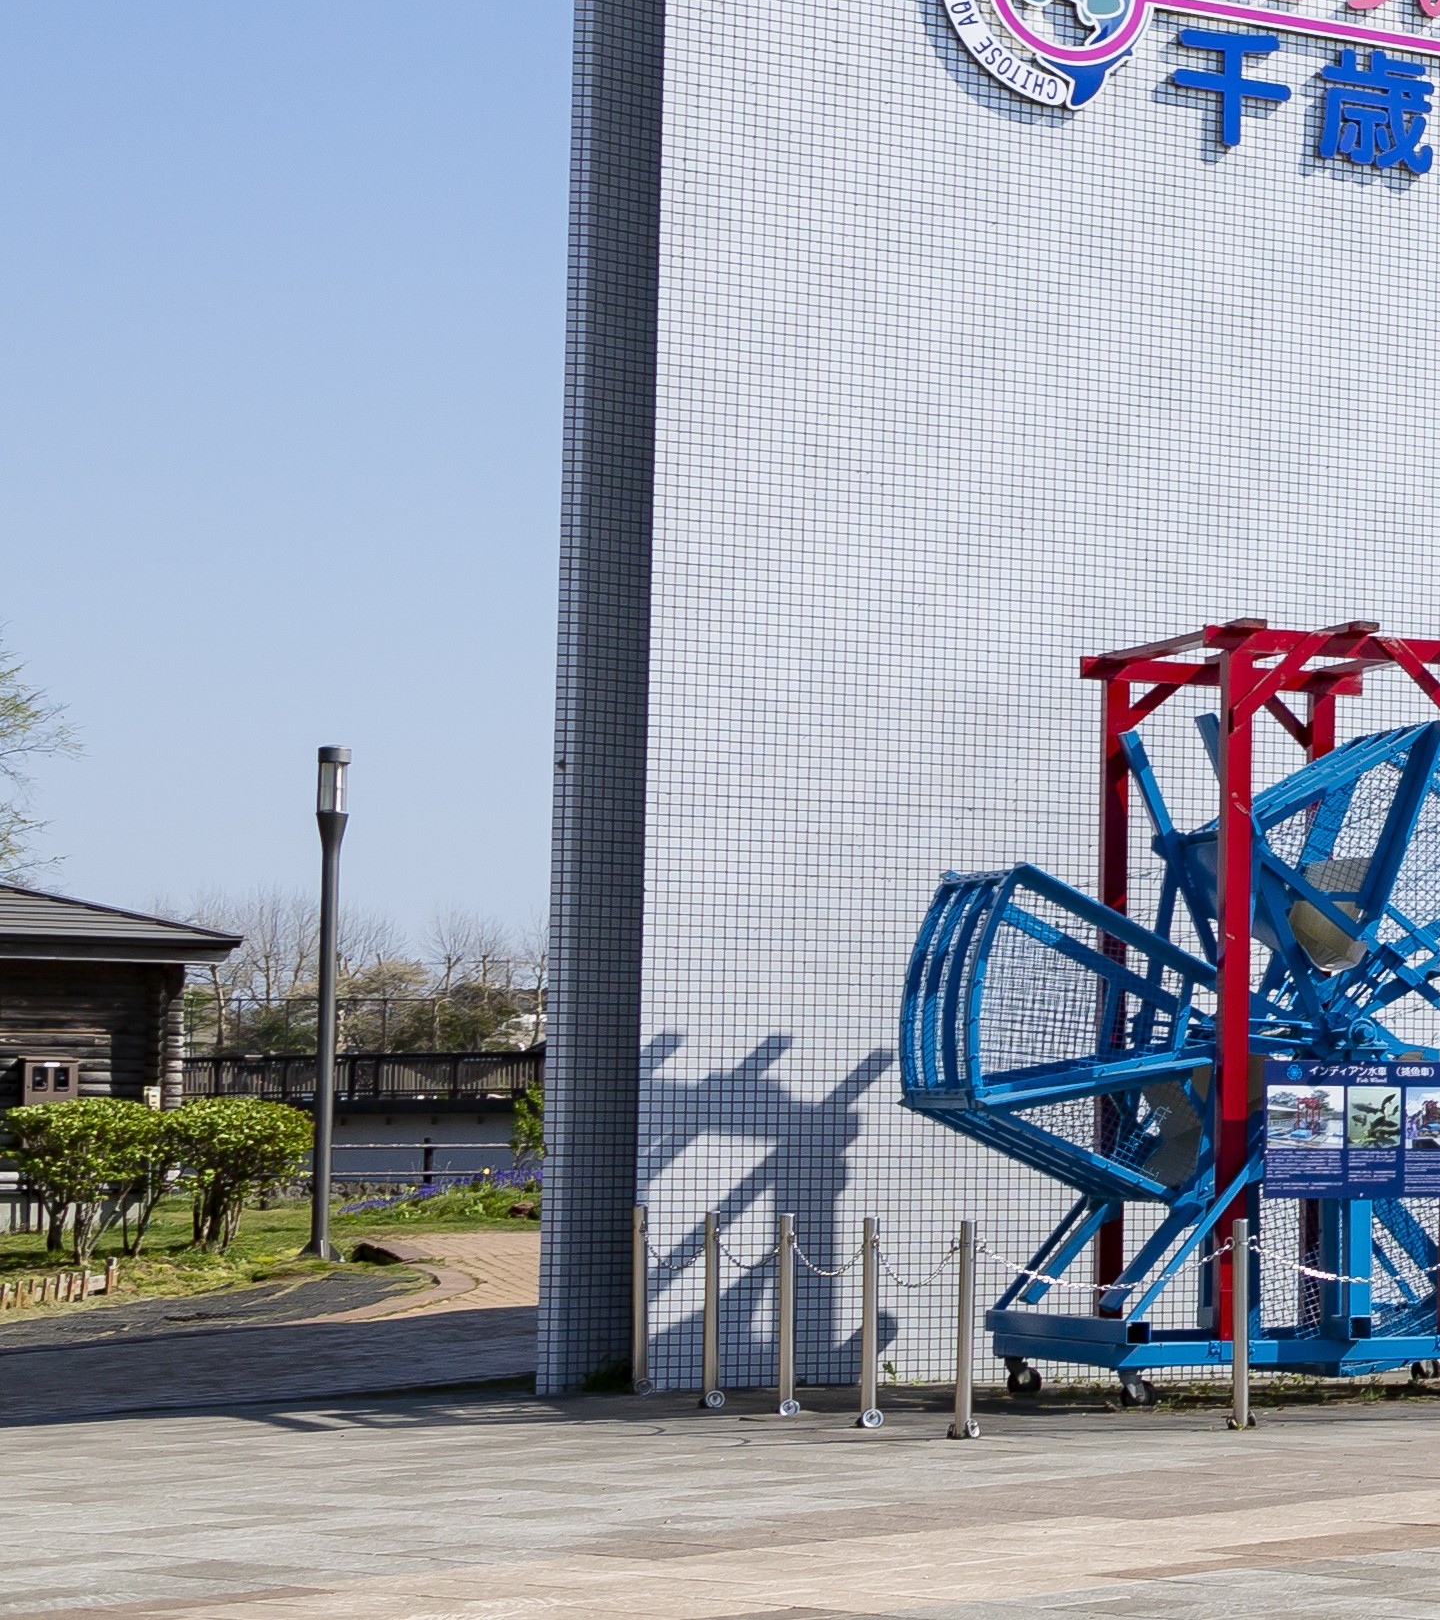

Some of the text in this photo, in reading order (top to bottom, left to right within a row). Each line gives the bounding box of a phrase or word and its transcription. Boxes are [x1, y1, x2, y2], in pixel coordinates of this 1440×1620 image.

[972, 35, 1058, 101] CHITOSE
[1308, 1065, 1388, 1078] インディアン水車
